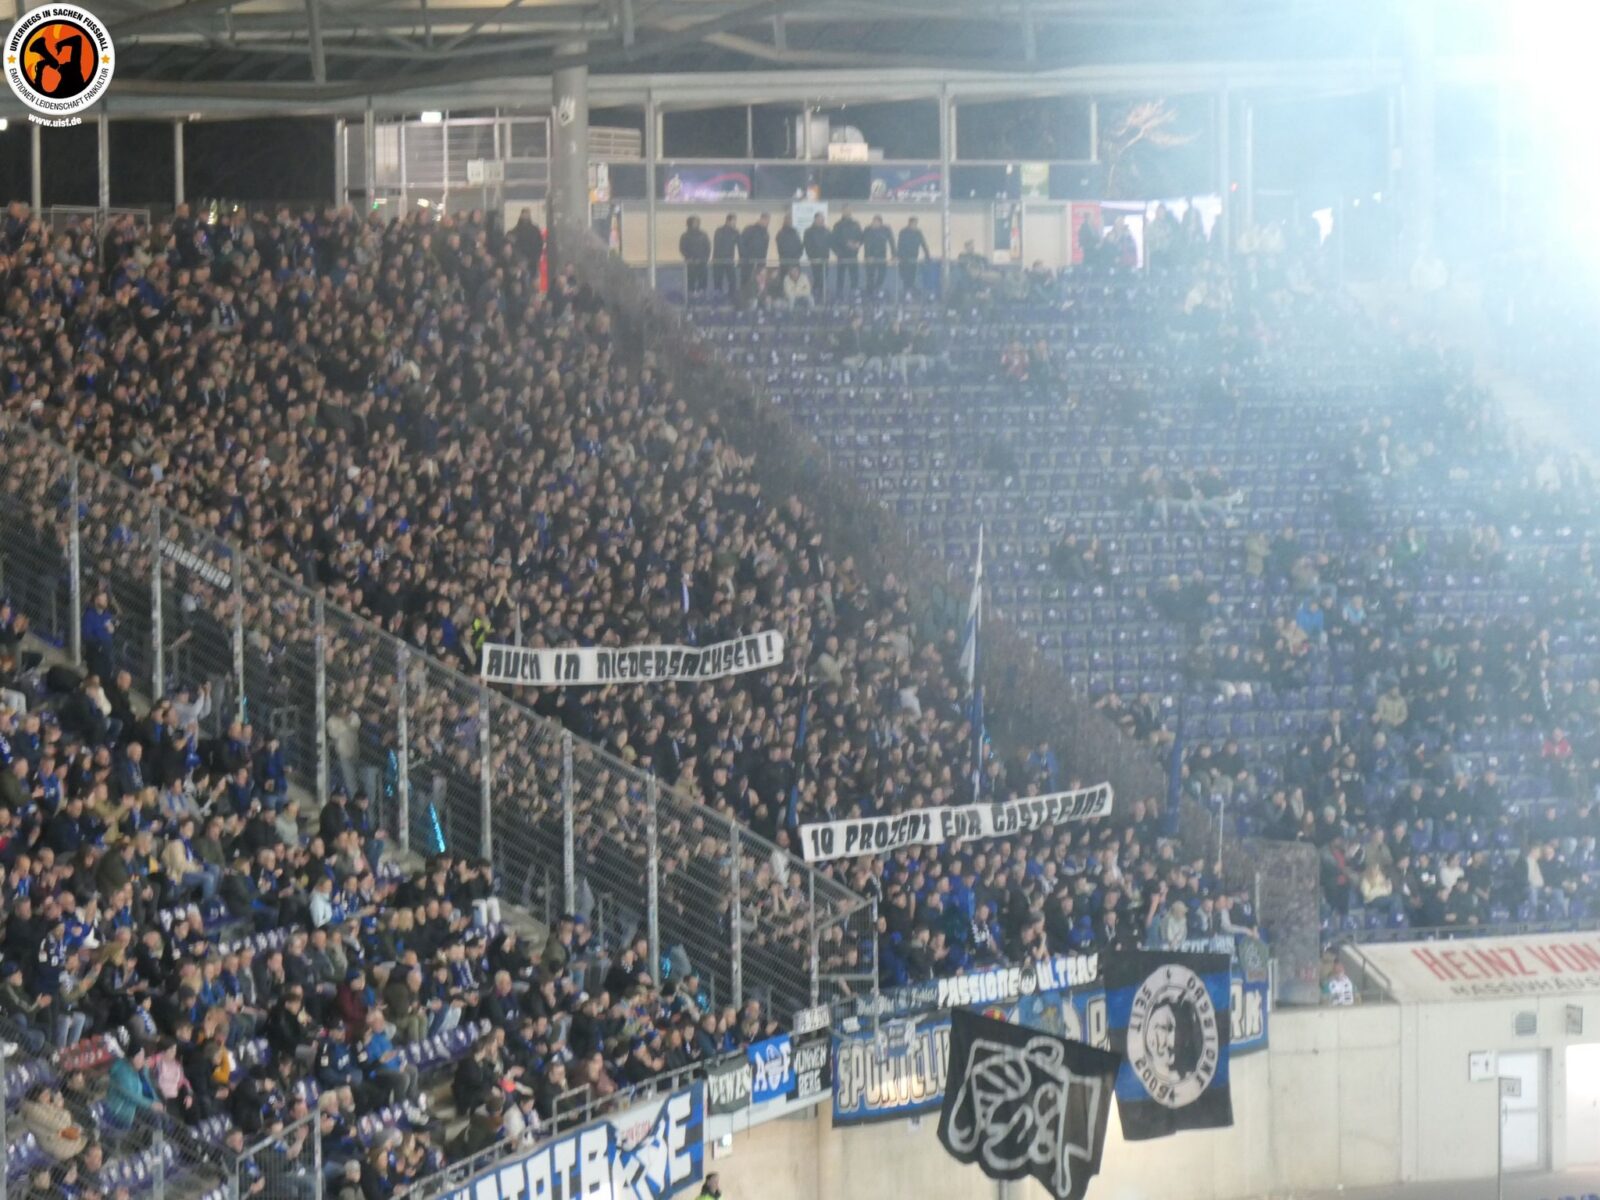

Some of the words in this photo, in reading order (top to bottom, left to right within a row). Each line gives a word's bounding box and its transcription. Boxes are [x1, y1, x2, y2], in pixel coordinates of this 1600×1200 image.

[487, 649, 540, 680] AUCH
[555, 653, 580, 680] IN
[811, 827, 834, 857] 10
[845, 813, 930, 853] PROZENT
[937, 967, 1020, 1010] PASSIONE
[1036, 952, 1098, 992] ULTRAS
[1411, 946, 1538, 980] HEINZ
[1525, 942, 1600, 973] VON
[837, 1024, 952, 1113] SPORTCLU
